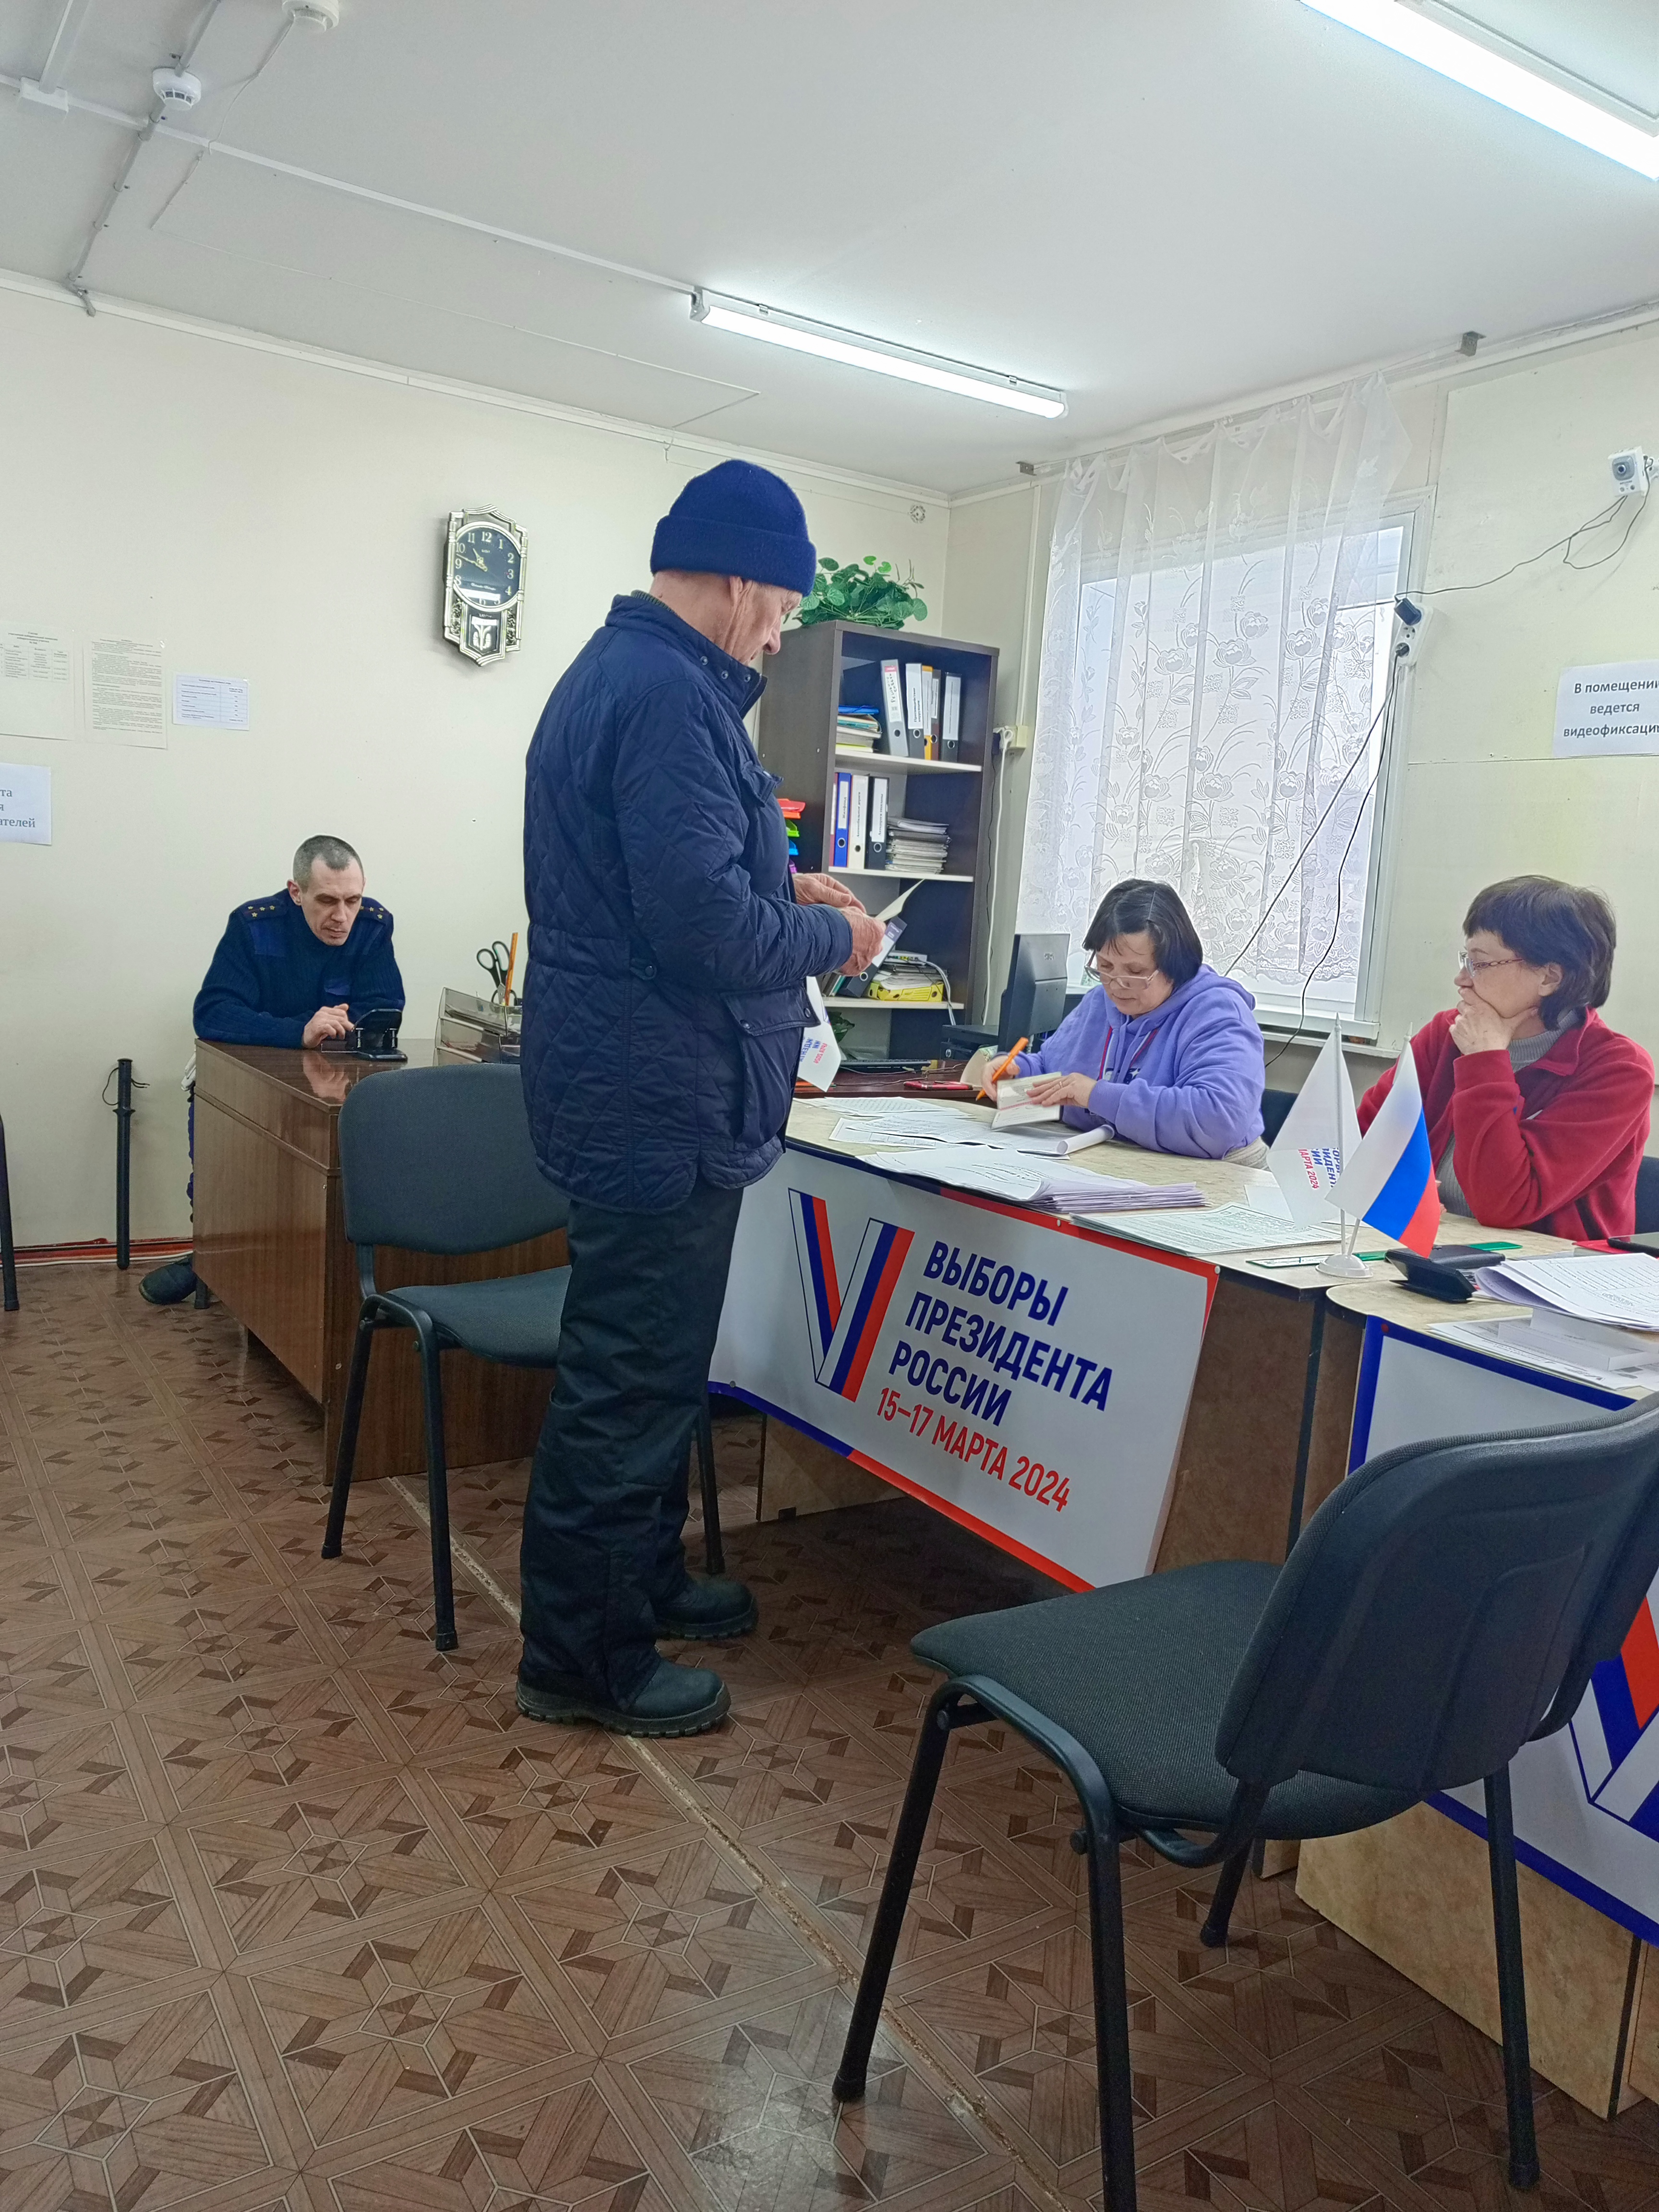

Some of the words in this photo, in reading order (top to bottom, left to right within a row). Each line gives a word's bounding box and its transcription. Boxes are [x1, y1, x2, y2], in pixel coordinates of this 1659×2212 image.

[468, 532, 475, 543] 11
[481, 531, 492, 542] 12
[456, 542, 465, 553] 10
[499, 539, 503, 549] 1
[455, 558, 462, 569] 9
[507, 553, 514, 564] 2
[507, 569, 514, 579] 3
[455, 575, 461, 586] 8
[505, 586, 511, 595] 4
[1575, 683, 1581, 694] В
[1590, 704, 1639, 715] ведется
[1307, 1171, 1319, 1189] 2024
[923, 1240, 1069, 1326] ВЫБОРЫ
[905, 1291, 1112, 1411] ПРЕЗИДЕНТА
[889, 1340, 1012, 1427] РОССИИ
[932, 1415, 1008, 1480] МАРТА
[1009, 1456, 1070, 1512] 2024
